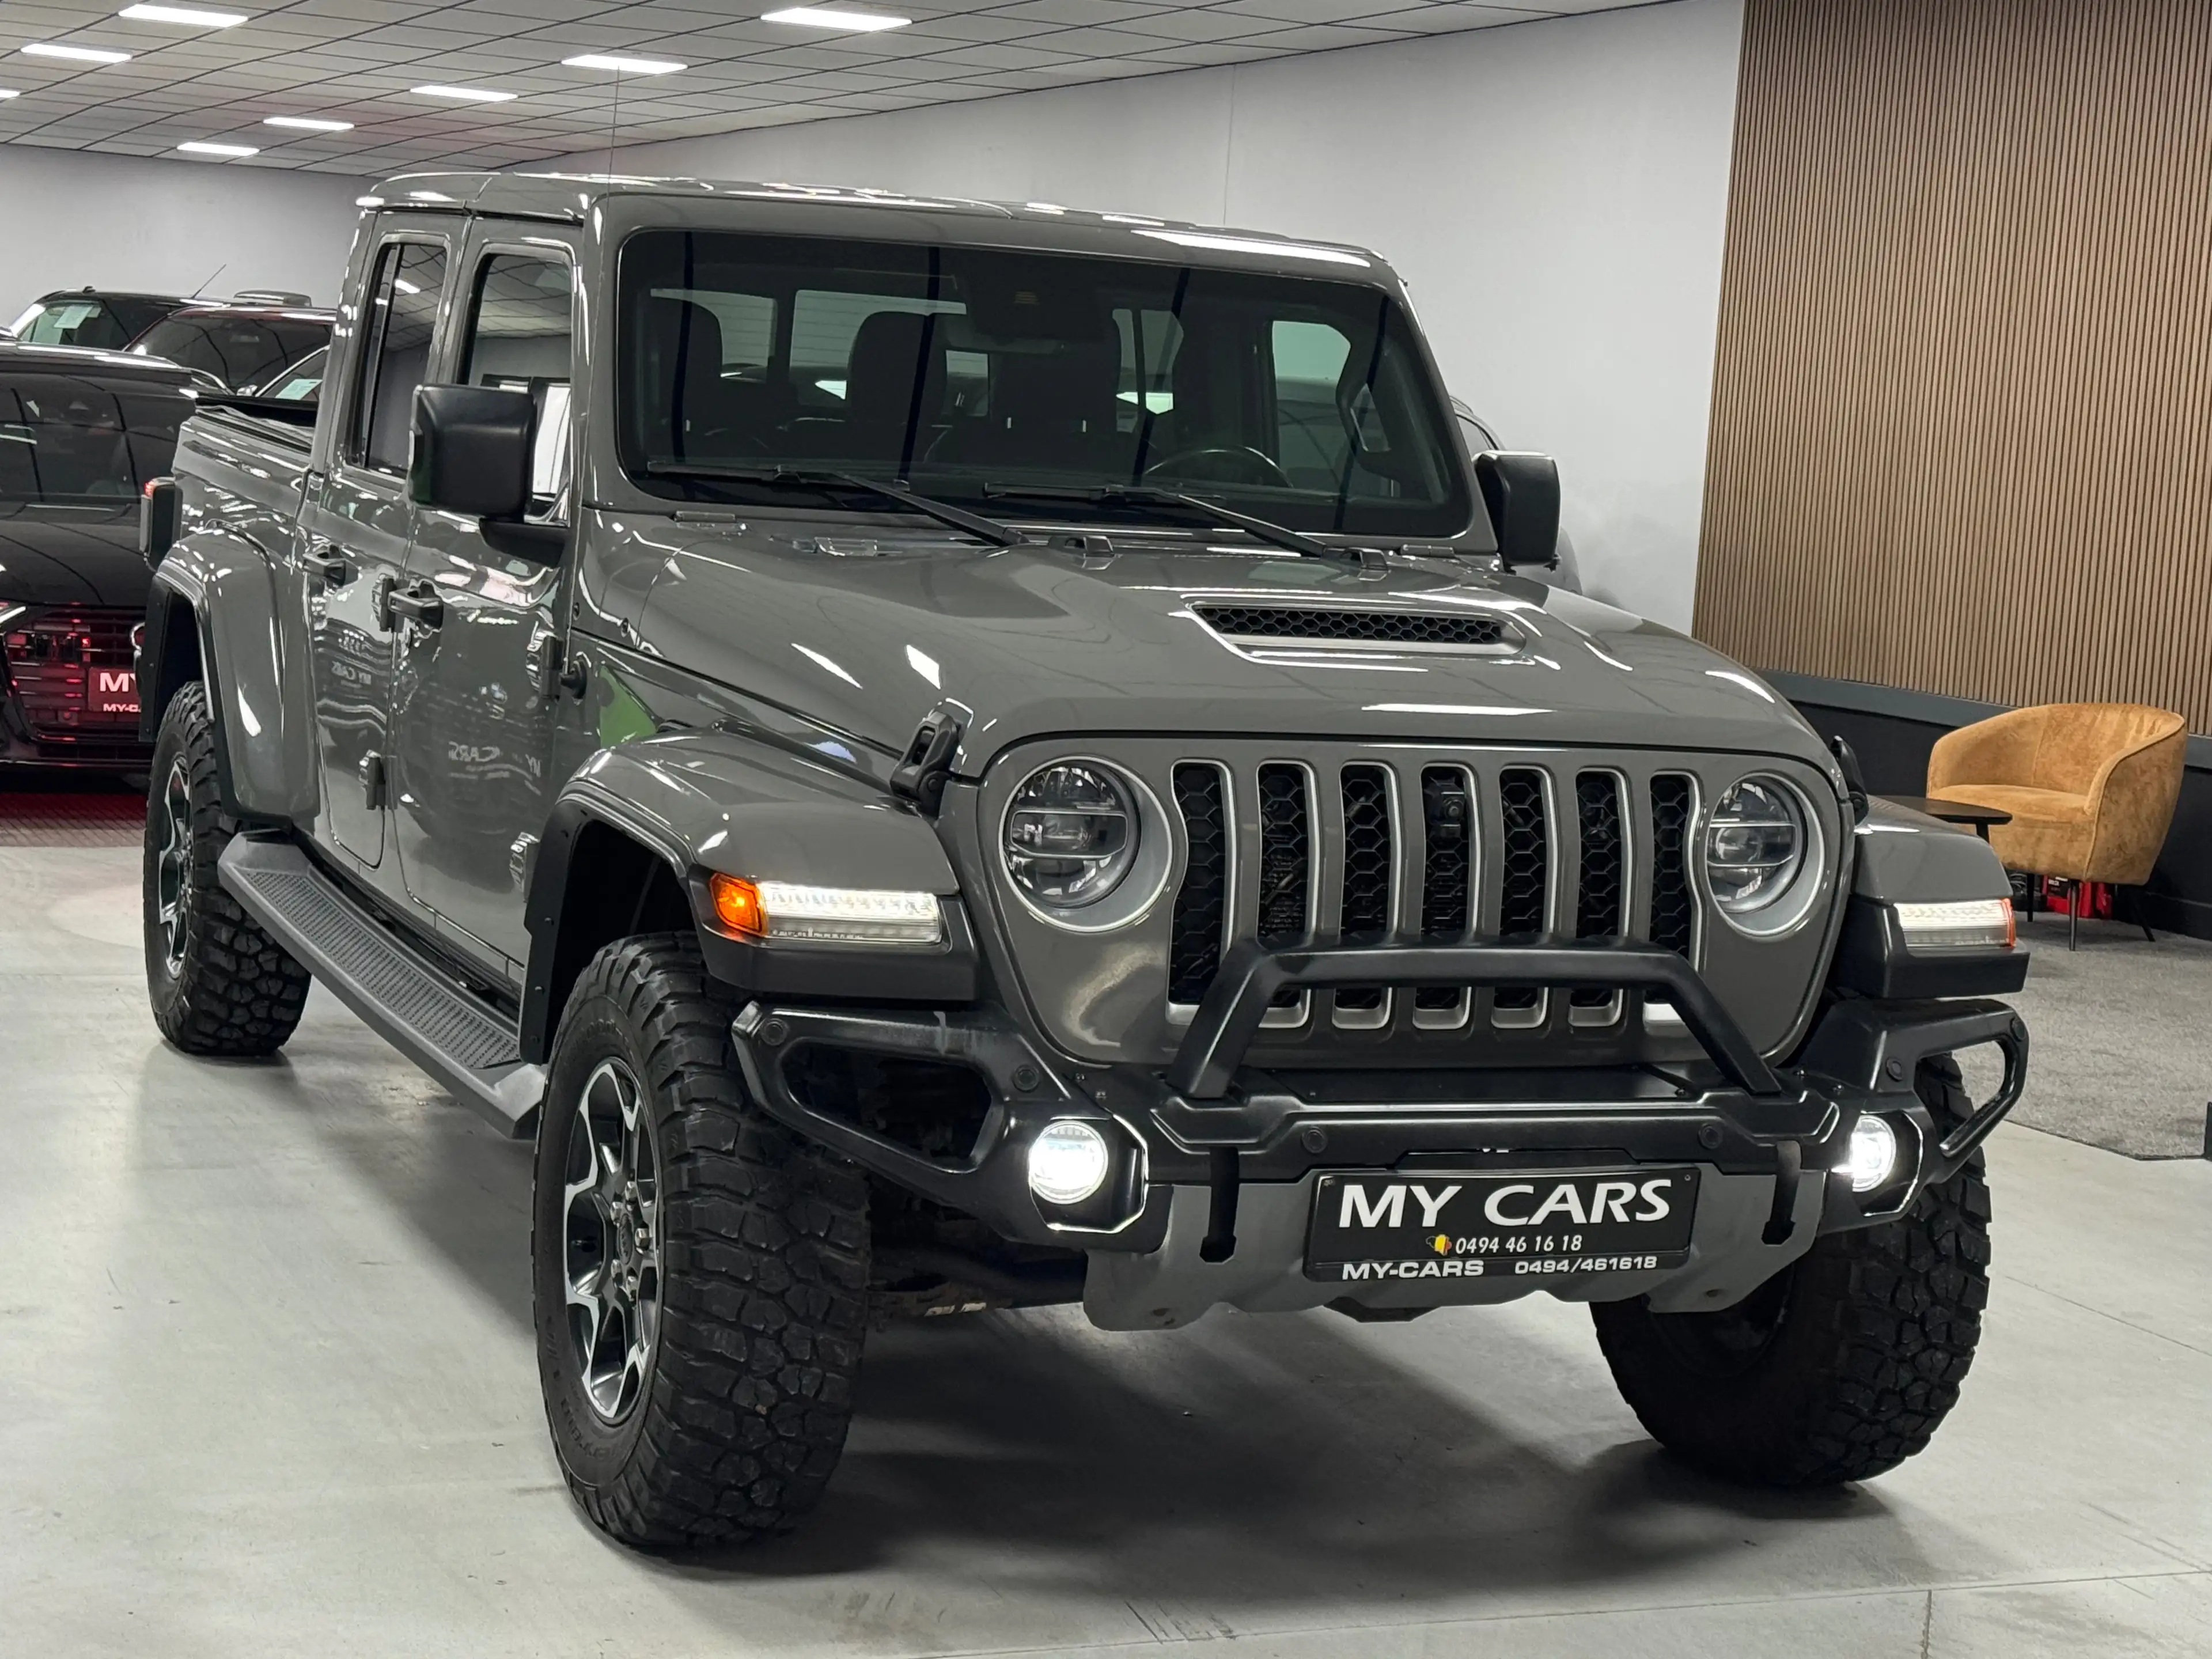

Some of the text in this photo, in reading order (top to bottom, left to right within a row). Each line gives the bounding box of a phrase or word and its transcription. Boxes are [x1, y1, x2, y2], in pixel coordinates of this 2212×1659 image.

[100, 672, 136, 692] M
[103, 703, 141, 713] MY-C
[1339, 1179, 1671, 1228] MY CARS
[1455, 1234, 1582, 1254] 0494 46 16 18
[1342, 1256, 1657, 1280] MY-CARS 0494/461618
